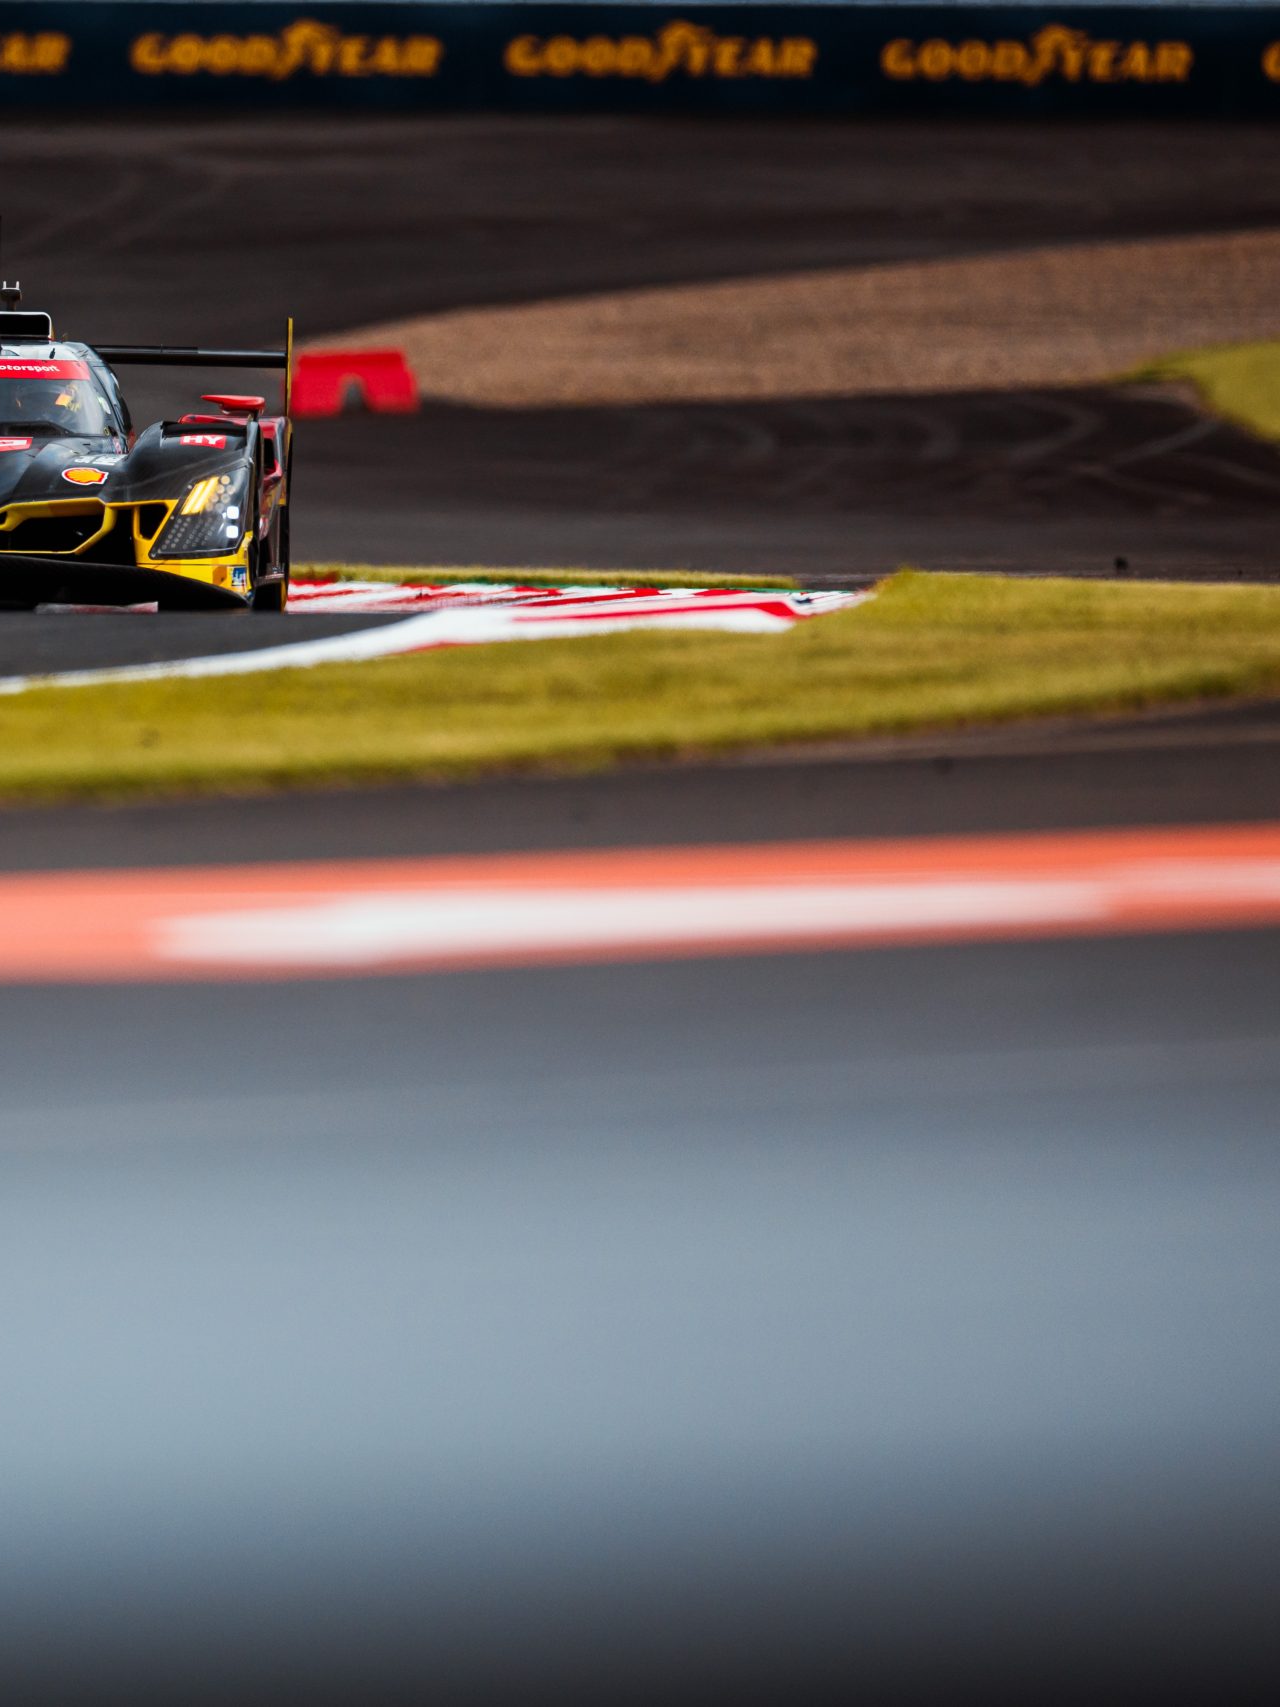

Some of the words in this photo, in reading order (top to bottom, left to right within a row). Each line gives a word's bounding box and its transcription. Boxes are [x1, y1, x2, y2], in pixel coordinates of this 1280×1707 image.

[131, 20, 442, 79] GOODYEAR
[505, 21, 817, 80] GOODYEAR
[881, 25, 1193, 85] GOODYEAR
[182, 435, 223, 445] HY
